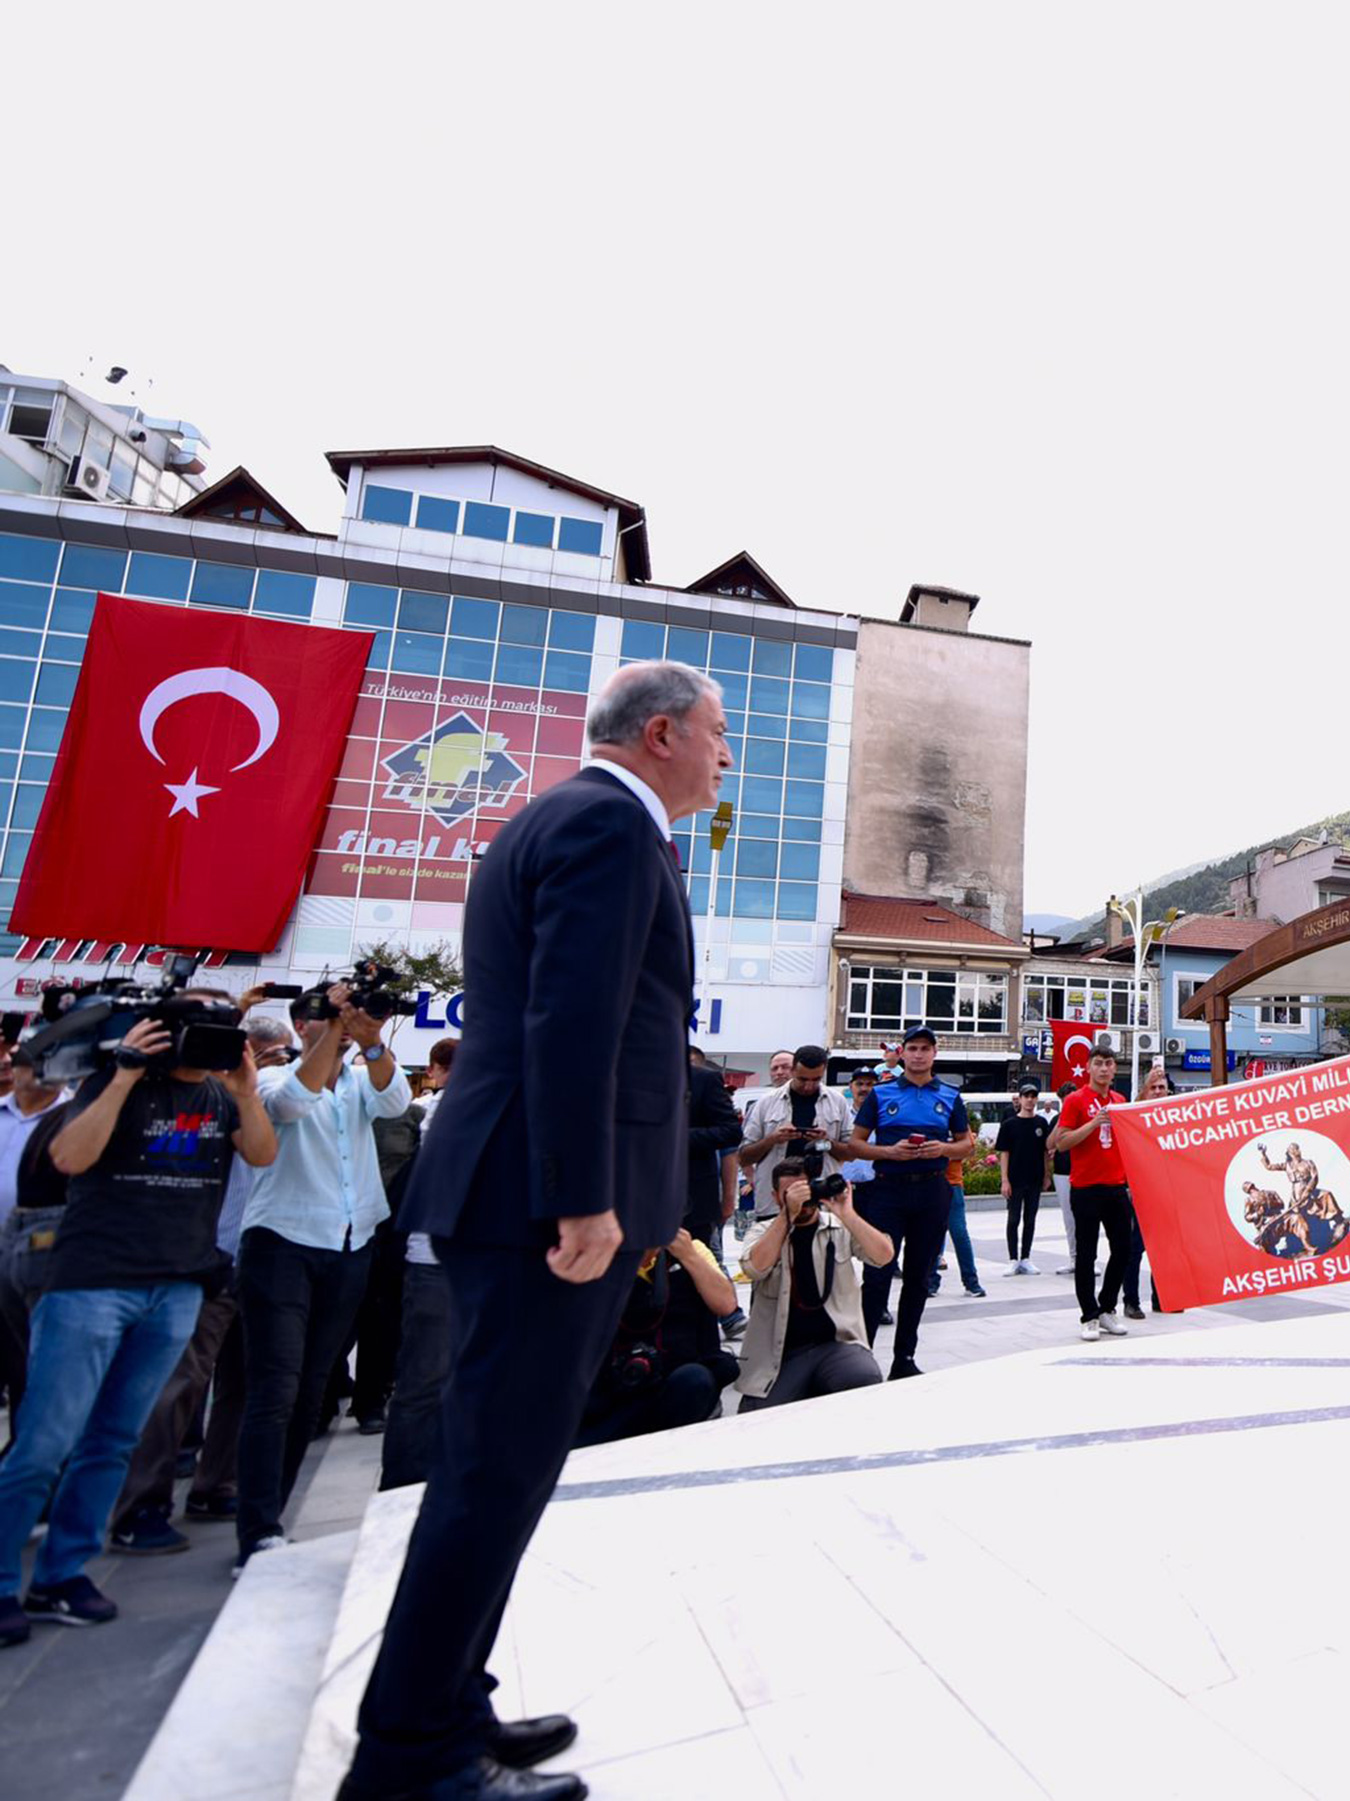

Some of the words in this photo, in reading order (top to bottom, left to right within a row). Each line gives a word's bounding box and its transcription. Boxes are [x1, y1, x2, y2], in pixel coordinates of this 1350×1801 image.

[451, 692, 498, 709] eğitim
[501, 700, 558, 715] markası
[337, 830, 441, 858] final
[1140, 1097, 1230, 1129] TÜRKİYE
[1234, 1078, 1308, 1112] KUVAYİ
[1157, 1109, 1292, 1151] MÜCAHİTLER
[1222, 1258, 1318, 1295] AKŞEHİR
